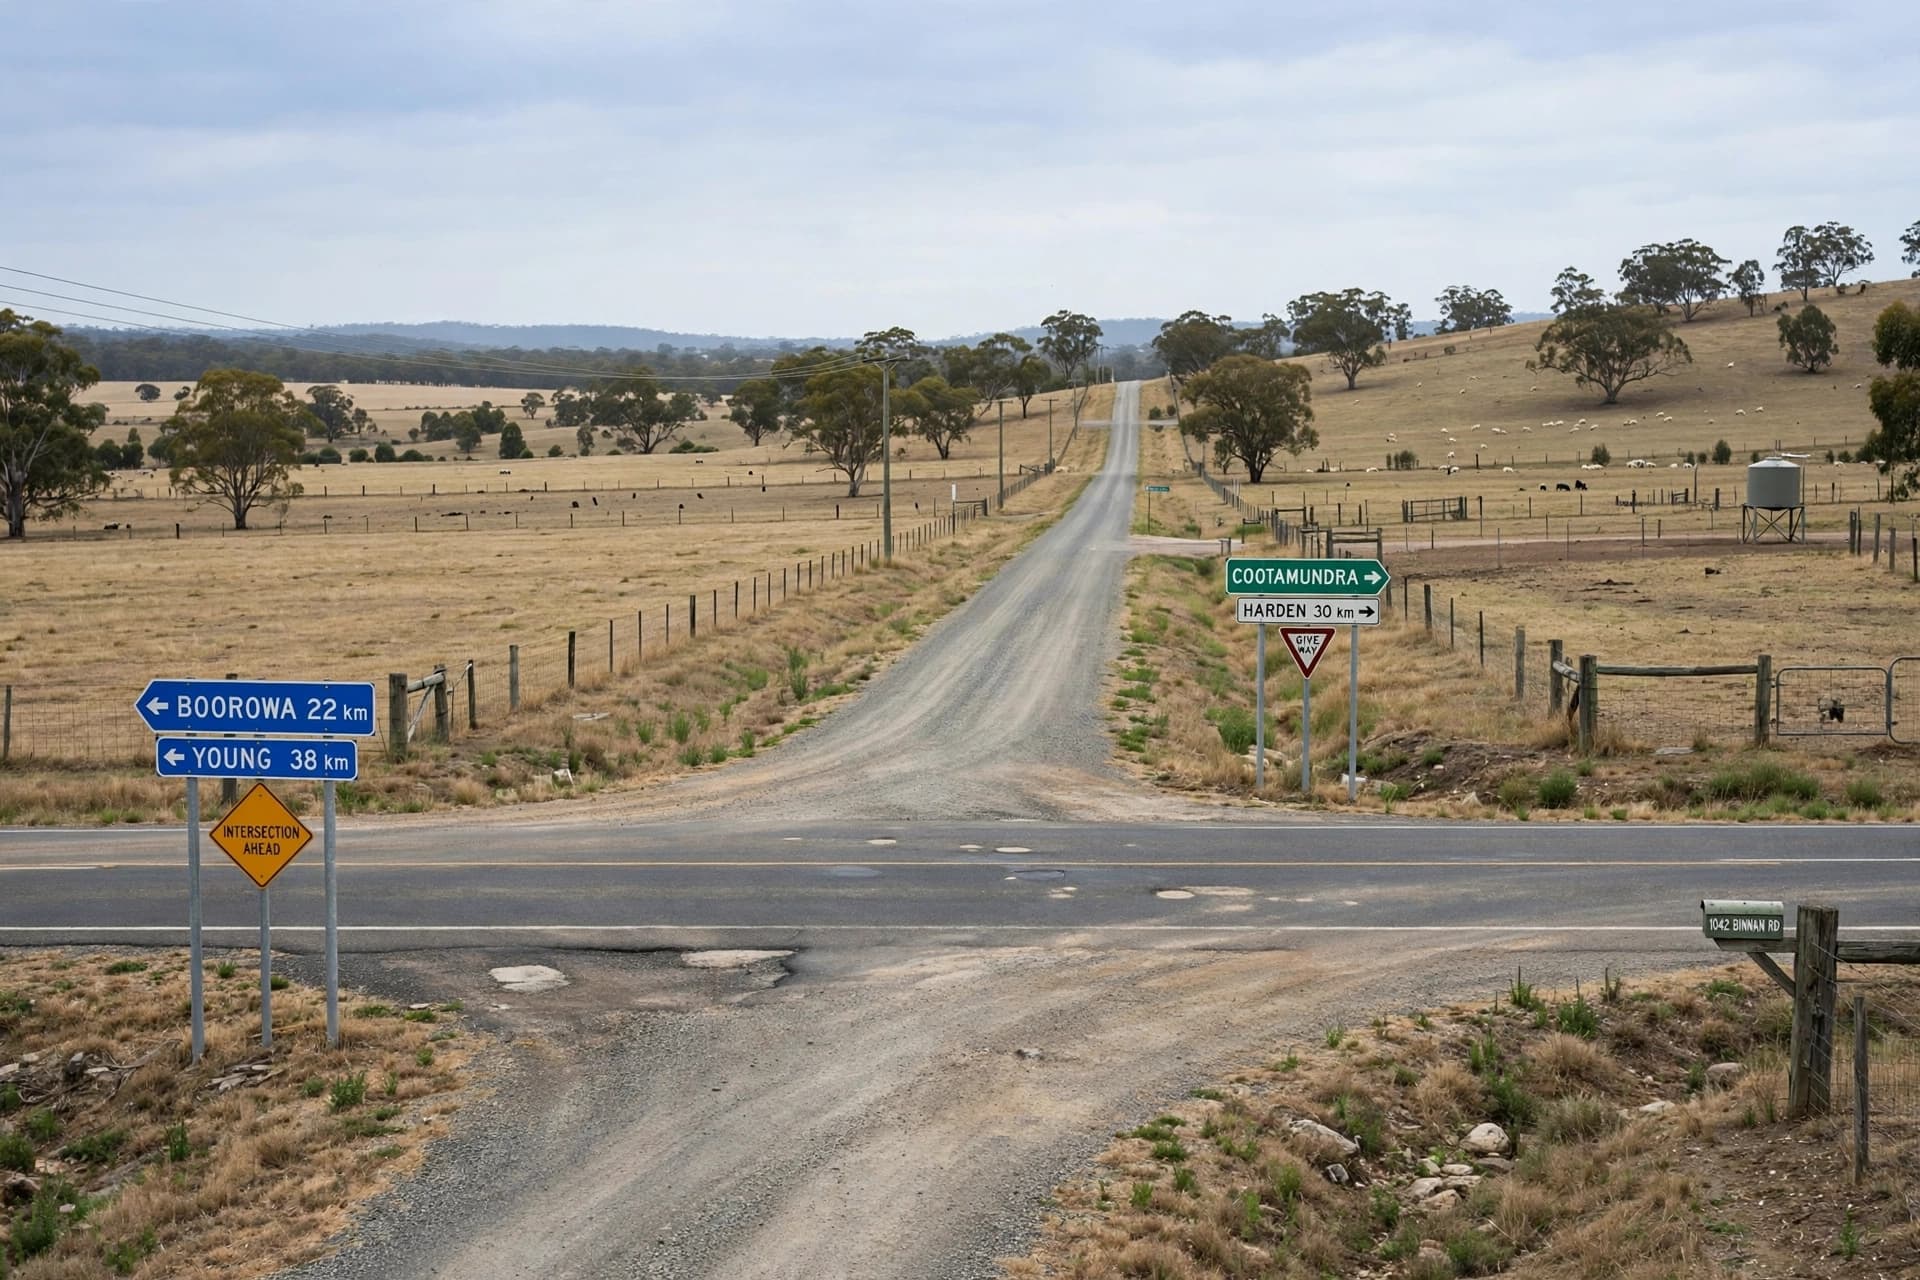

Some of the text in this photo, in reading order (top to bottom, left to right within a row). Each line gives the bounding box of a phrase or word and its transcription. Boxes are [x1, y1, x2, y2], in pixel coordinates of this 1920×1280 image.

[1232, 567, 1359, 585] COOTAMUNDRA
[1243, 603, 1354, 619] HARDEN 30 km
[1296, 635, 1320, 645] GIVE
[1298, 645, 1318, 655] WAY
[177, 695, 368, 721] BOOROWA 22 km
[192, 746, 349, 771] YOUNG 38 km
[223, 825, 300, 839] INTERSECTION
[243, 842, 281, 856] AHEAD
[1709, 917, 1730, 931] 1042
[1767, 919, 1781, 932] RD
